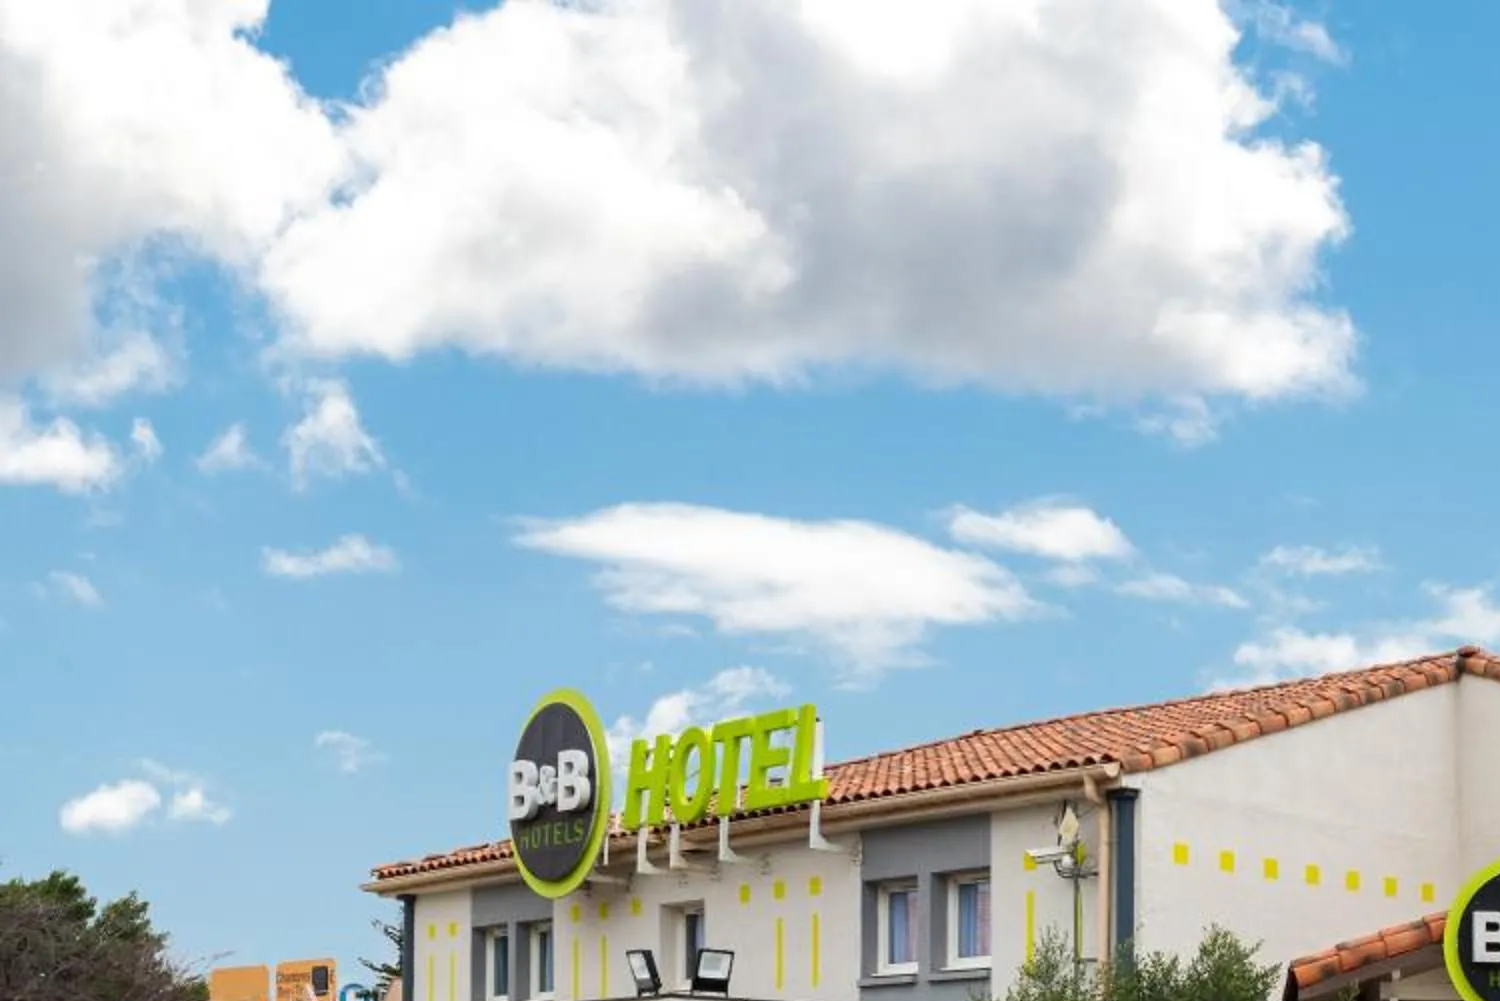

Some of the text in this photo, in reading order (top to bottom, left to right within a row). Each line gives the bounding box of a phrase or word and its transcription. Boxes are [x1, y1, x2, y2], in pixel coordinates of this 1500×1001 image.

[509, 749, 591, 820] B&B
[624, 704, 828, 829] HOTEL
[520, 820, 585, 850] HOTELS
